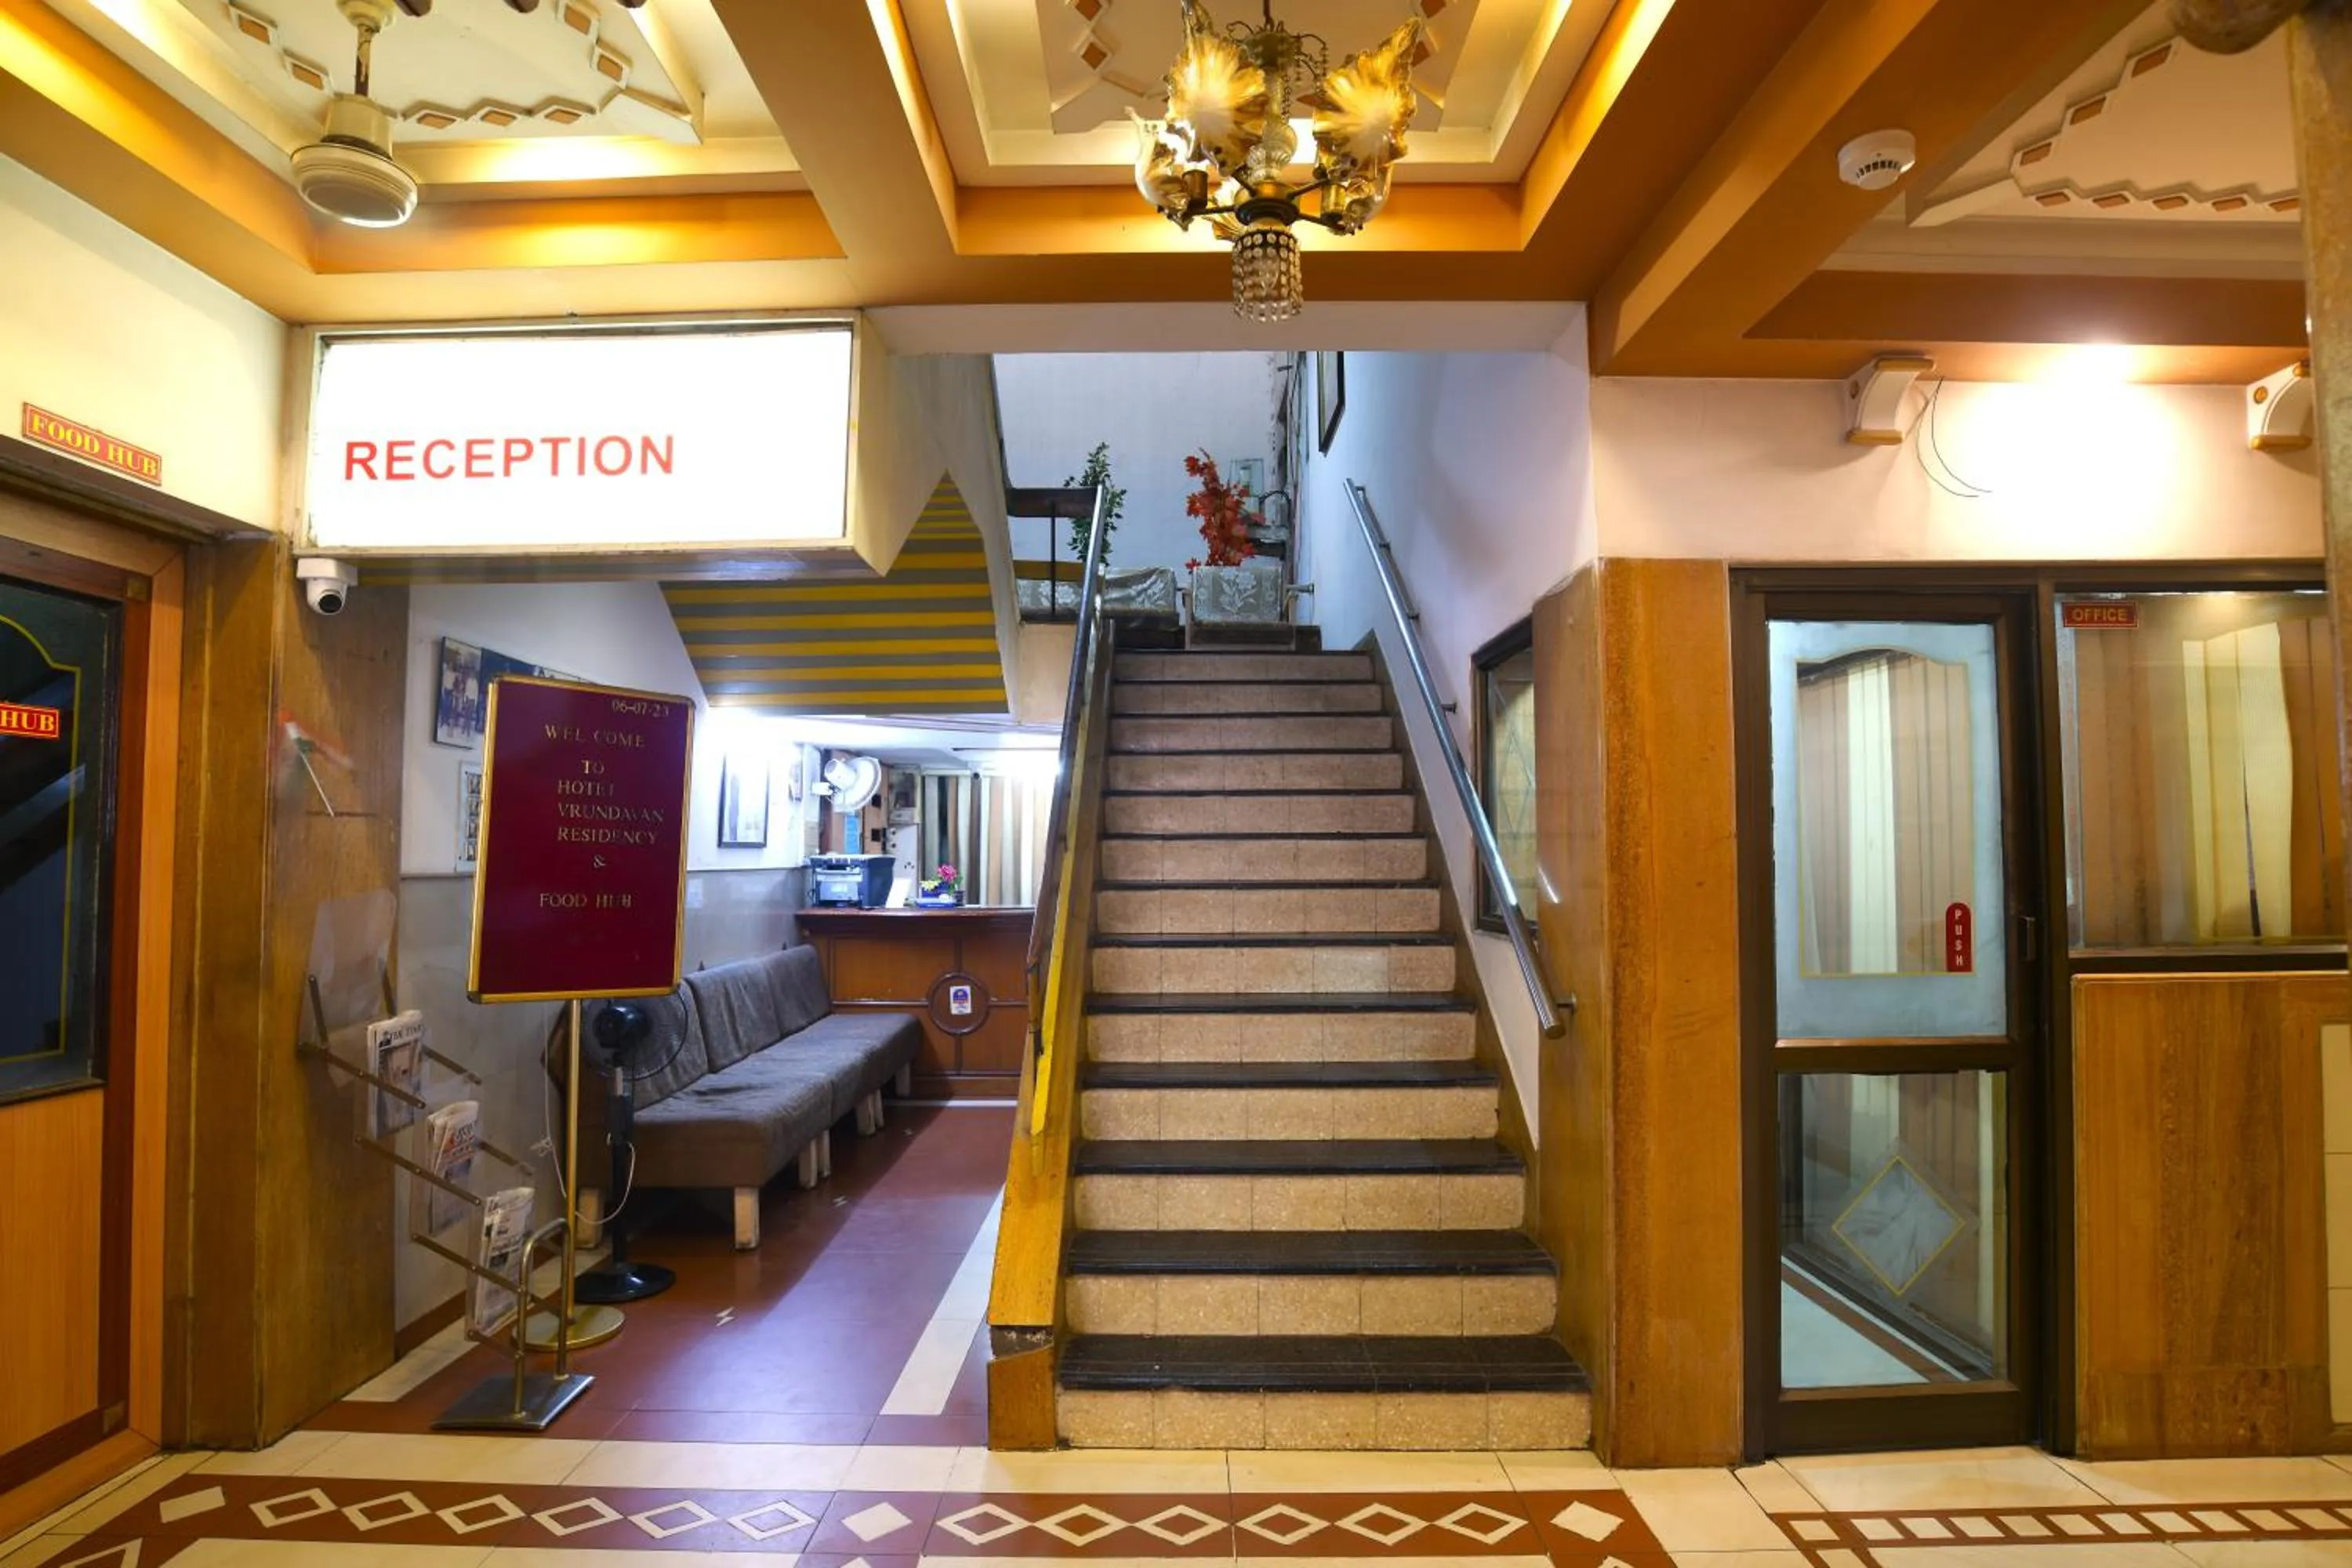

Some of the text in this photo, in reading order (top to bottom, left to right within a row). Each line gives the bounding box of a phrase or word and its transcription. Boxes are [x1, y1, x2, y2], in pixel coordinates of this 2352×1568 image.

[31, 413, 157, 477] FOOD HUB
[345, 435, 673, 481] RECEPTION
[2072, 608, 2128, 622] OFFICE
[0, 710, 55, 731] HUB
[581, 759, 605, 775] TO
[557, 826, 657, 845] RESIDENCY
[593, 854, 607, 869] &
[539, 892, 588, 909] FOOD
[1955, 908, 1964, 967] PUSH
